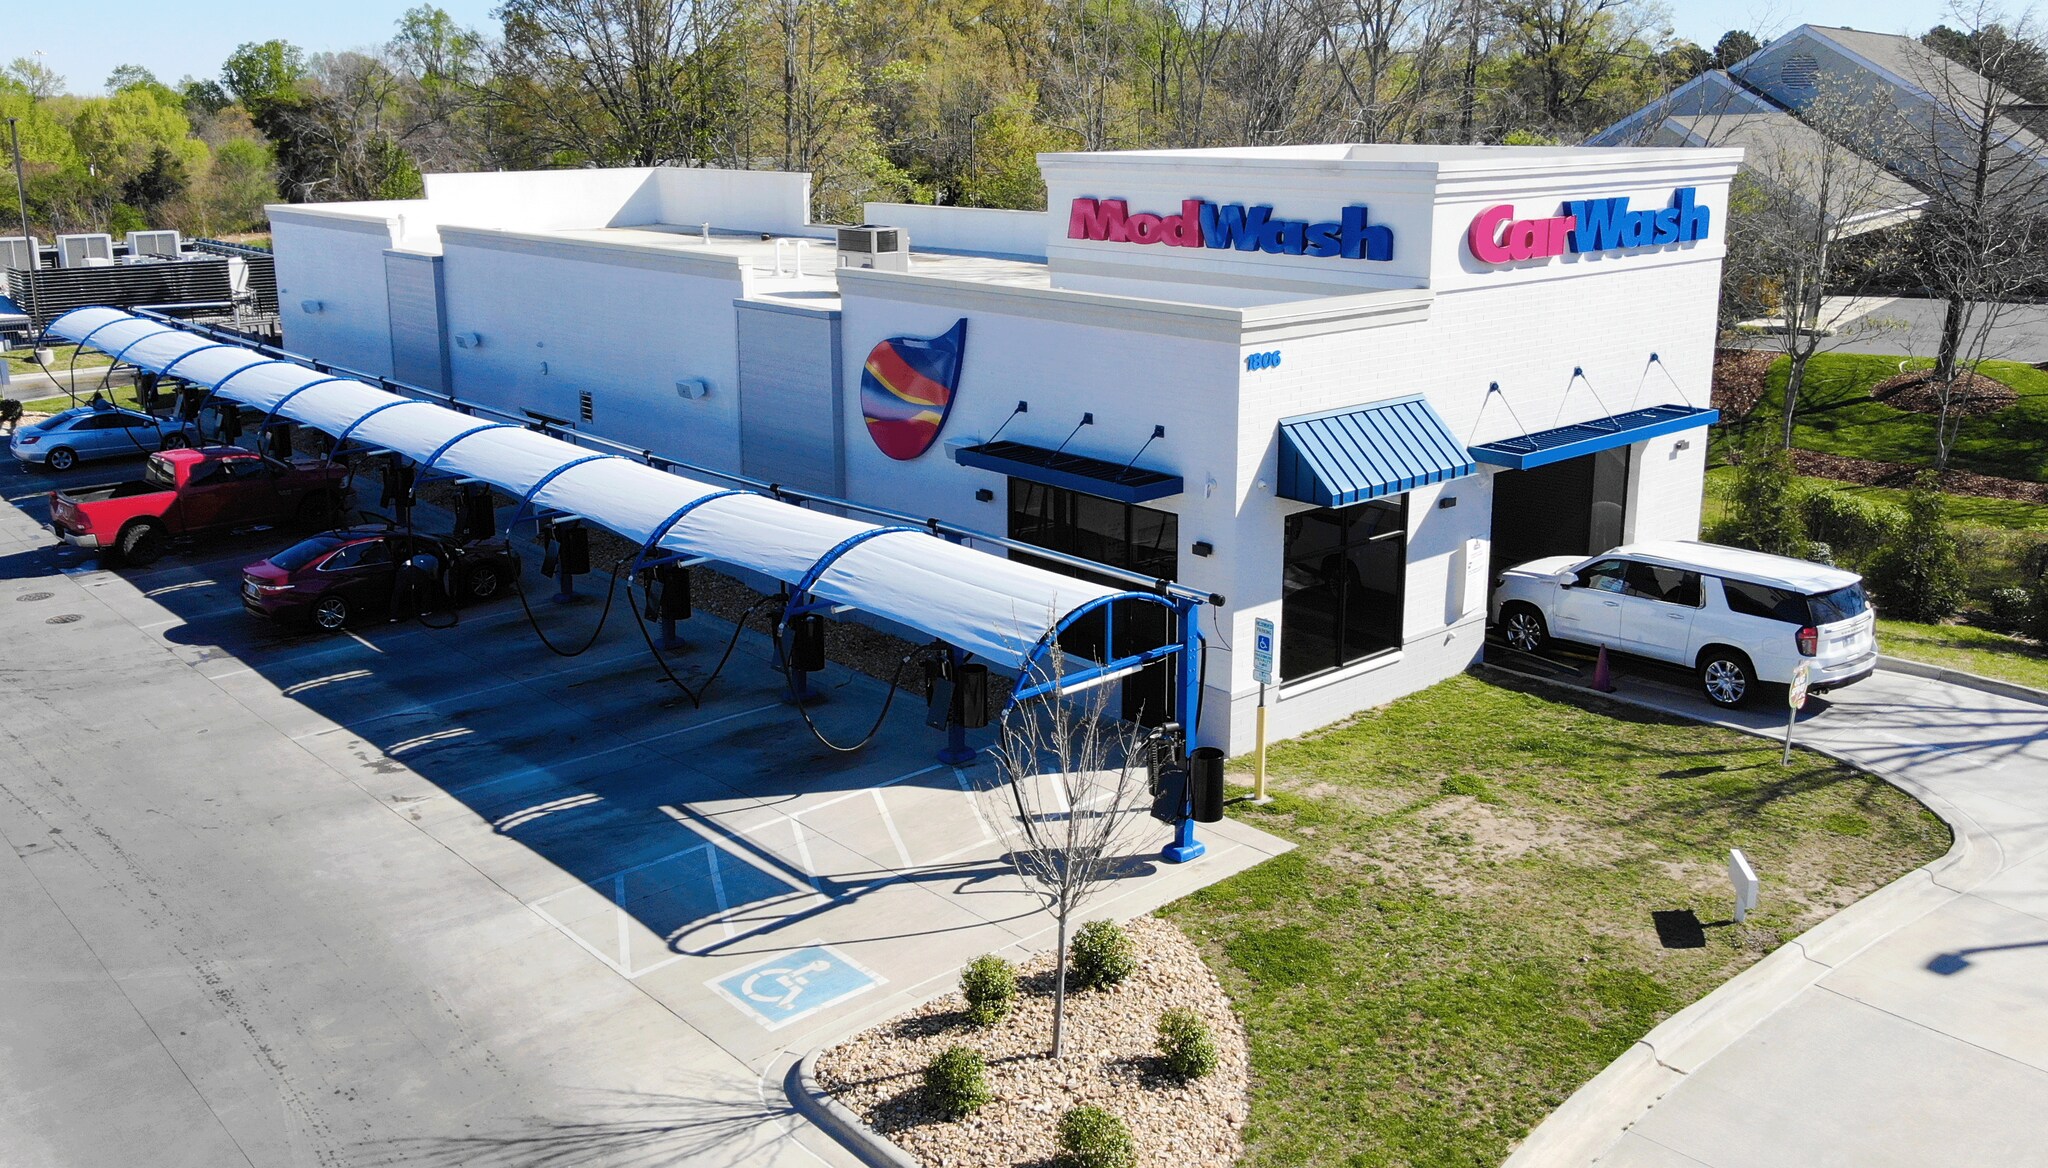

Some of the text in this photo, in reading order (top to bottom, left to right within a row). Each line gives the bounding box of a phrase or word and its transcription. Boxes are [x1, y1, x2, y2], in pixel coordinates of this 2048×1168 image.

[1068, 197, 1395, 262] ModWash
[1467, 186, 1711, 265] CarWash
[1248, 350, 1281, 371] 1806
